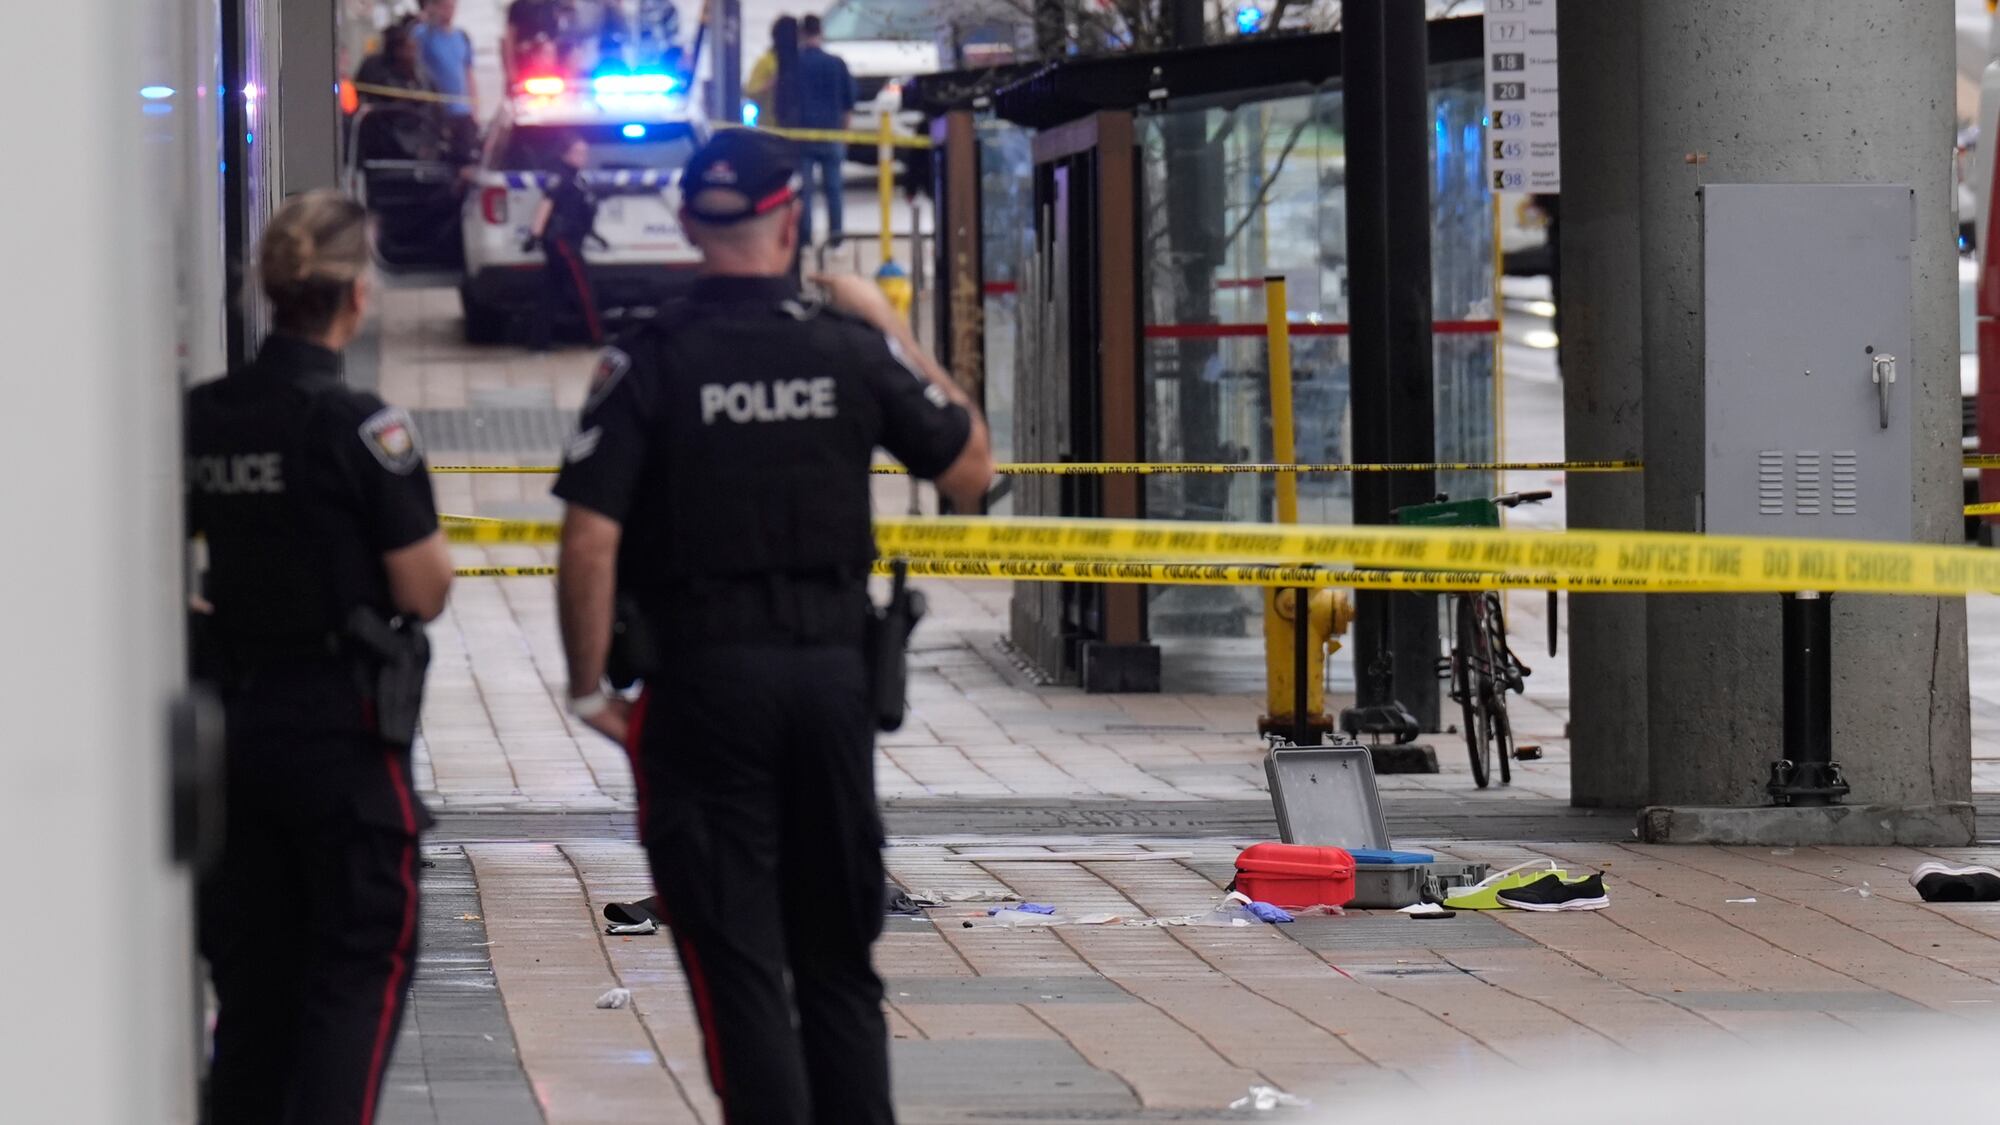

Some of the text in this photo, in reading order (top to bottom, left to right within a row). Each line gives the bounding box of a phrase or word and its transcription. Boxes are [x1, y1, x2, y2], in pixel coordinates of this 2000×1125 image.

[1500, 26, 1515, 39] 17
[1499, 55, 1516, 70] 18
[1500, 84, 1518, 99] 20
[1506, 112, 1521, 127] 39
[1505, 143, 1521, 157] 45
[1505, 173, 1522, 187] 98
[700, 376, 837, 425] POLICE
